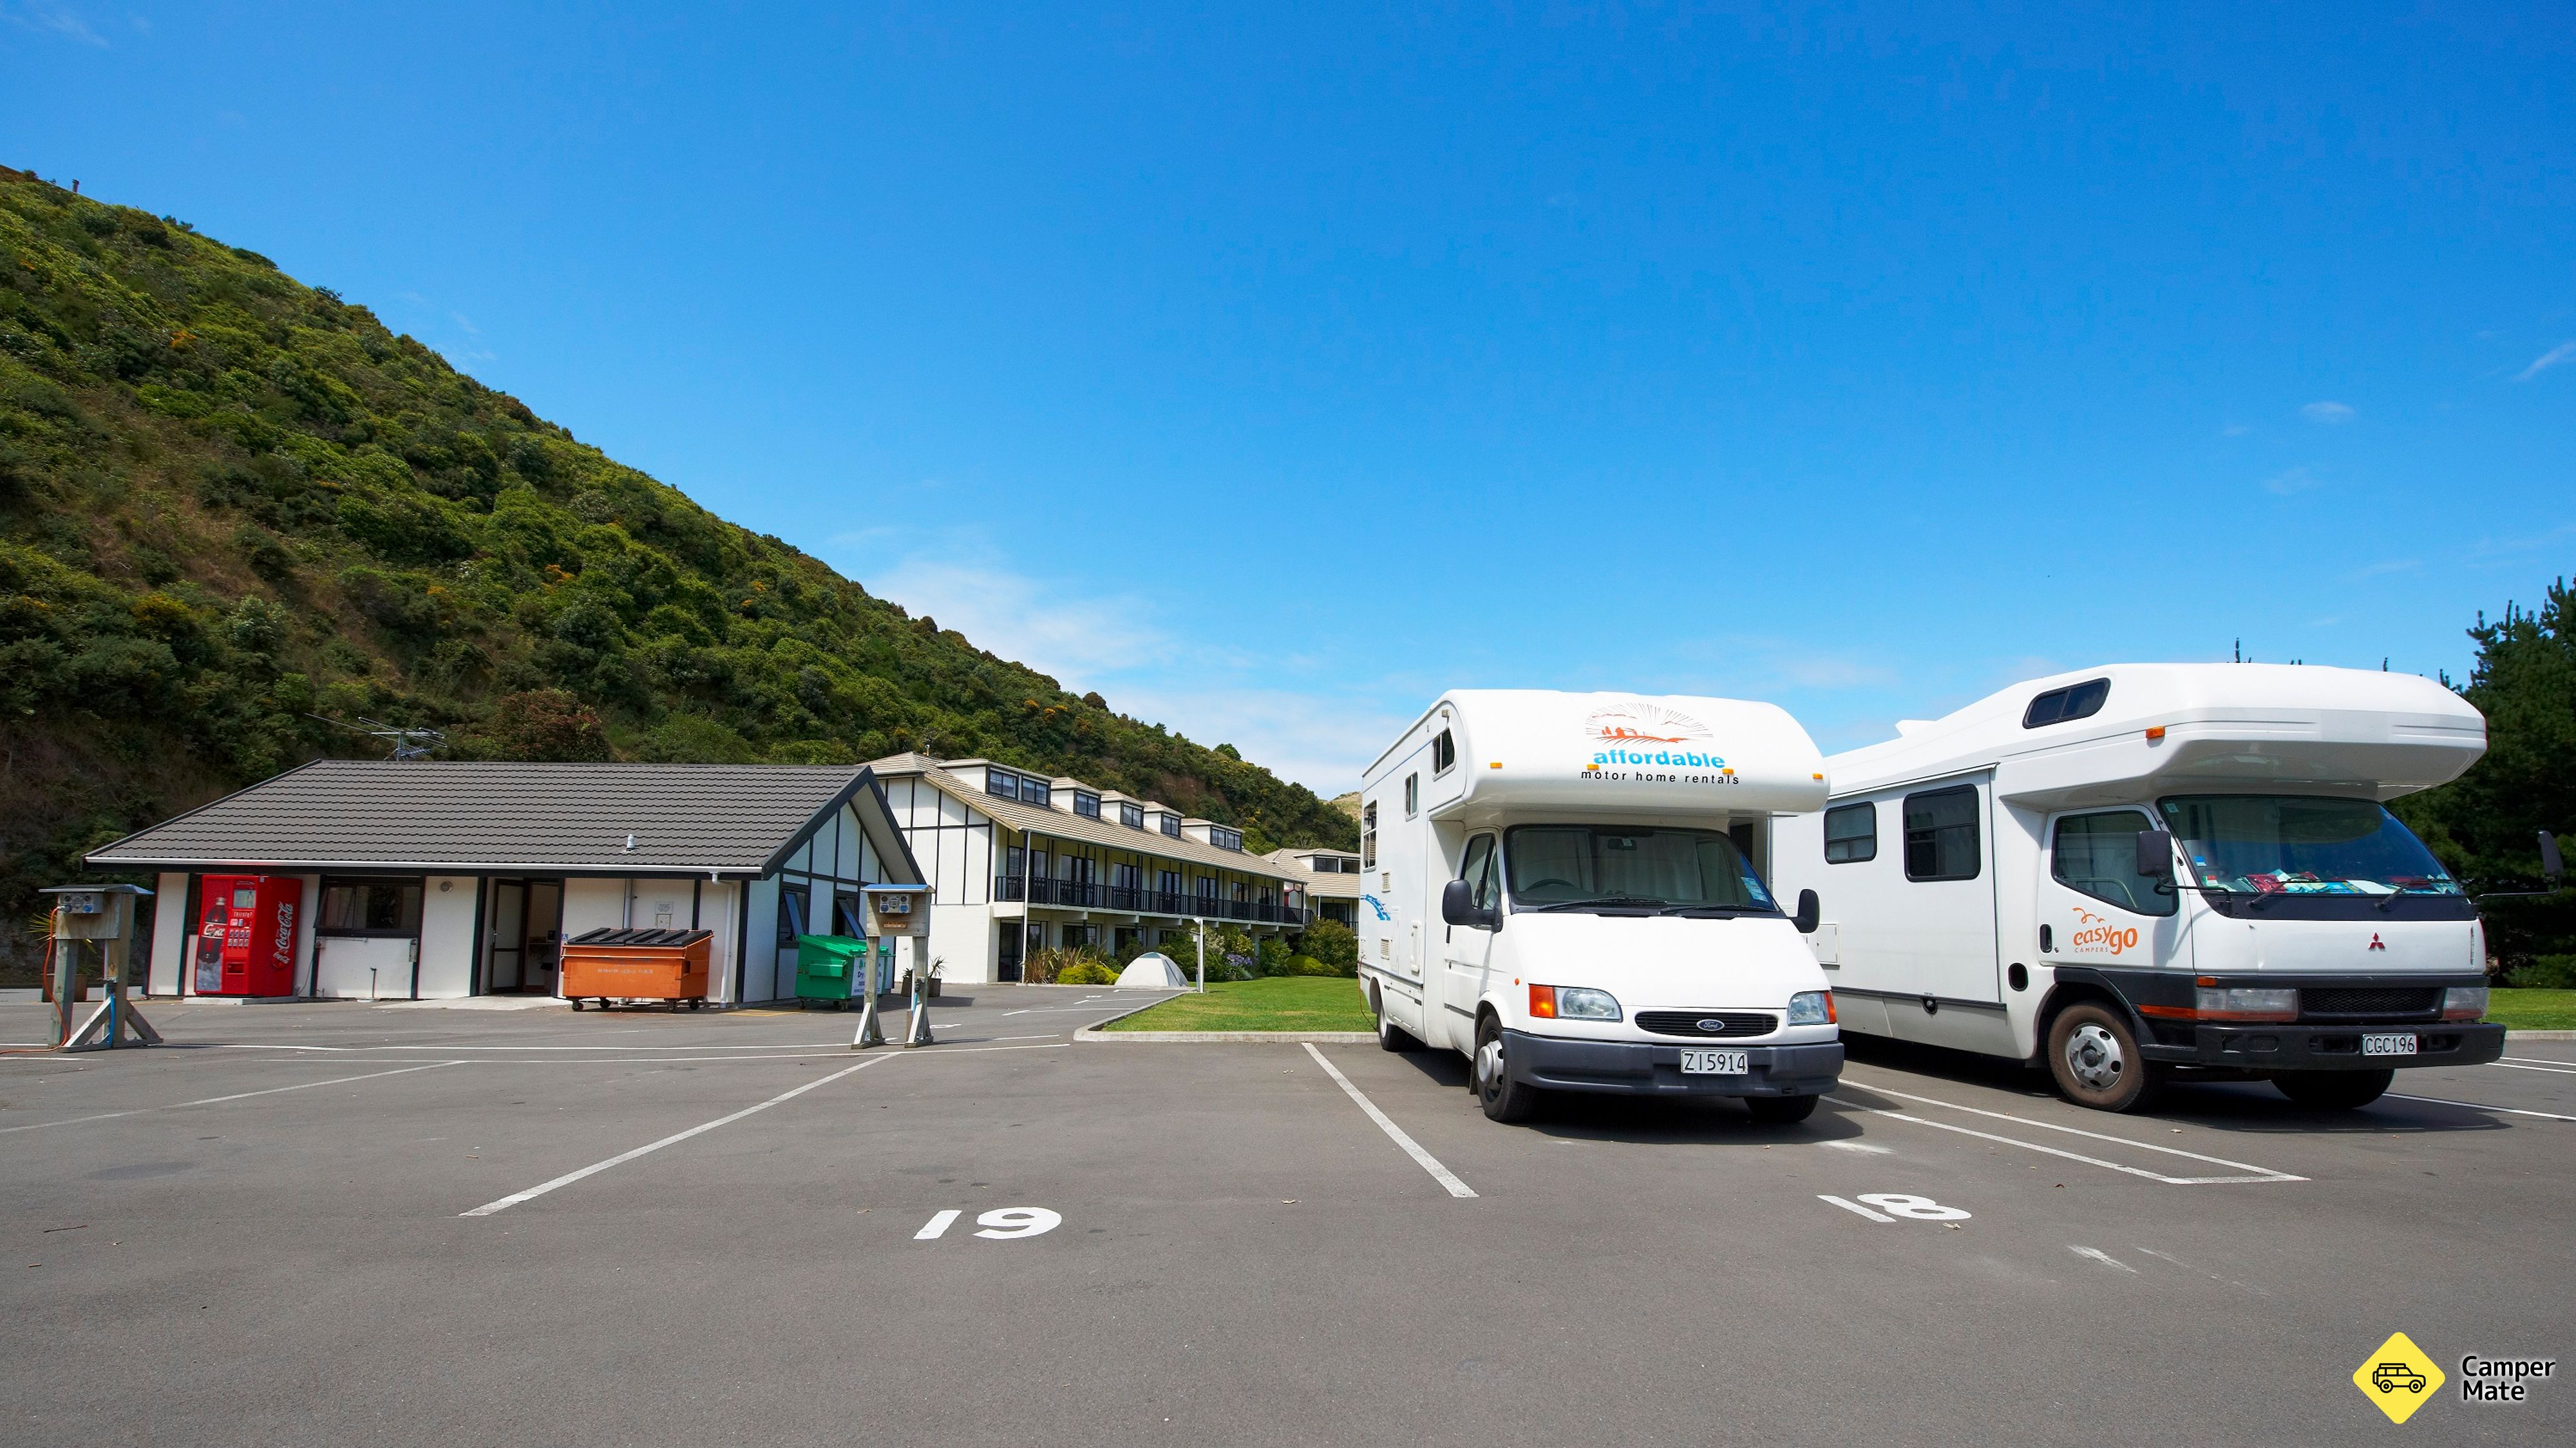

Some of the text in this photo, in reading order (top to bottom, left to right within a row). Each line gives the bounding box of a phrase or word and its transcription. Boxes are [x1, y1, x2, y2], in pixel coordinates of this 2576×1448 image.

[1593, 749, 1726, 768] affordable
[1581, 771, 1739, 785] motor home rentals
[2073, 925, 2138, 955] easygo
[2365, 1036, 2415, 1053] CGC196
[1816, 1194, 1972, 1223] 18
[913, 1206, 1063, 1239] 19
